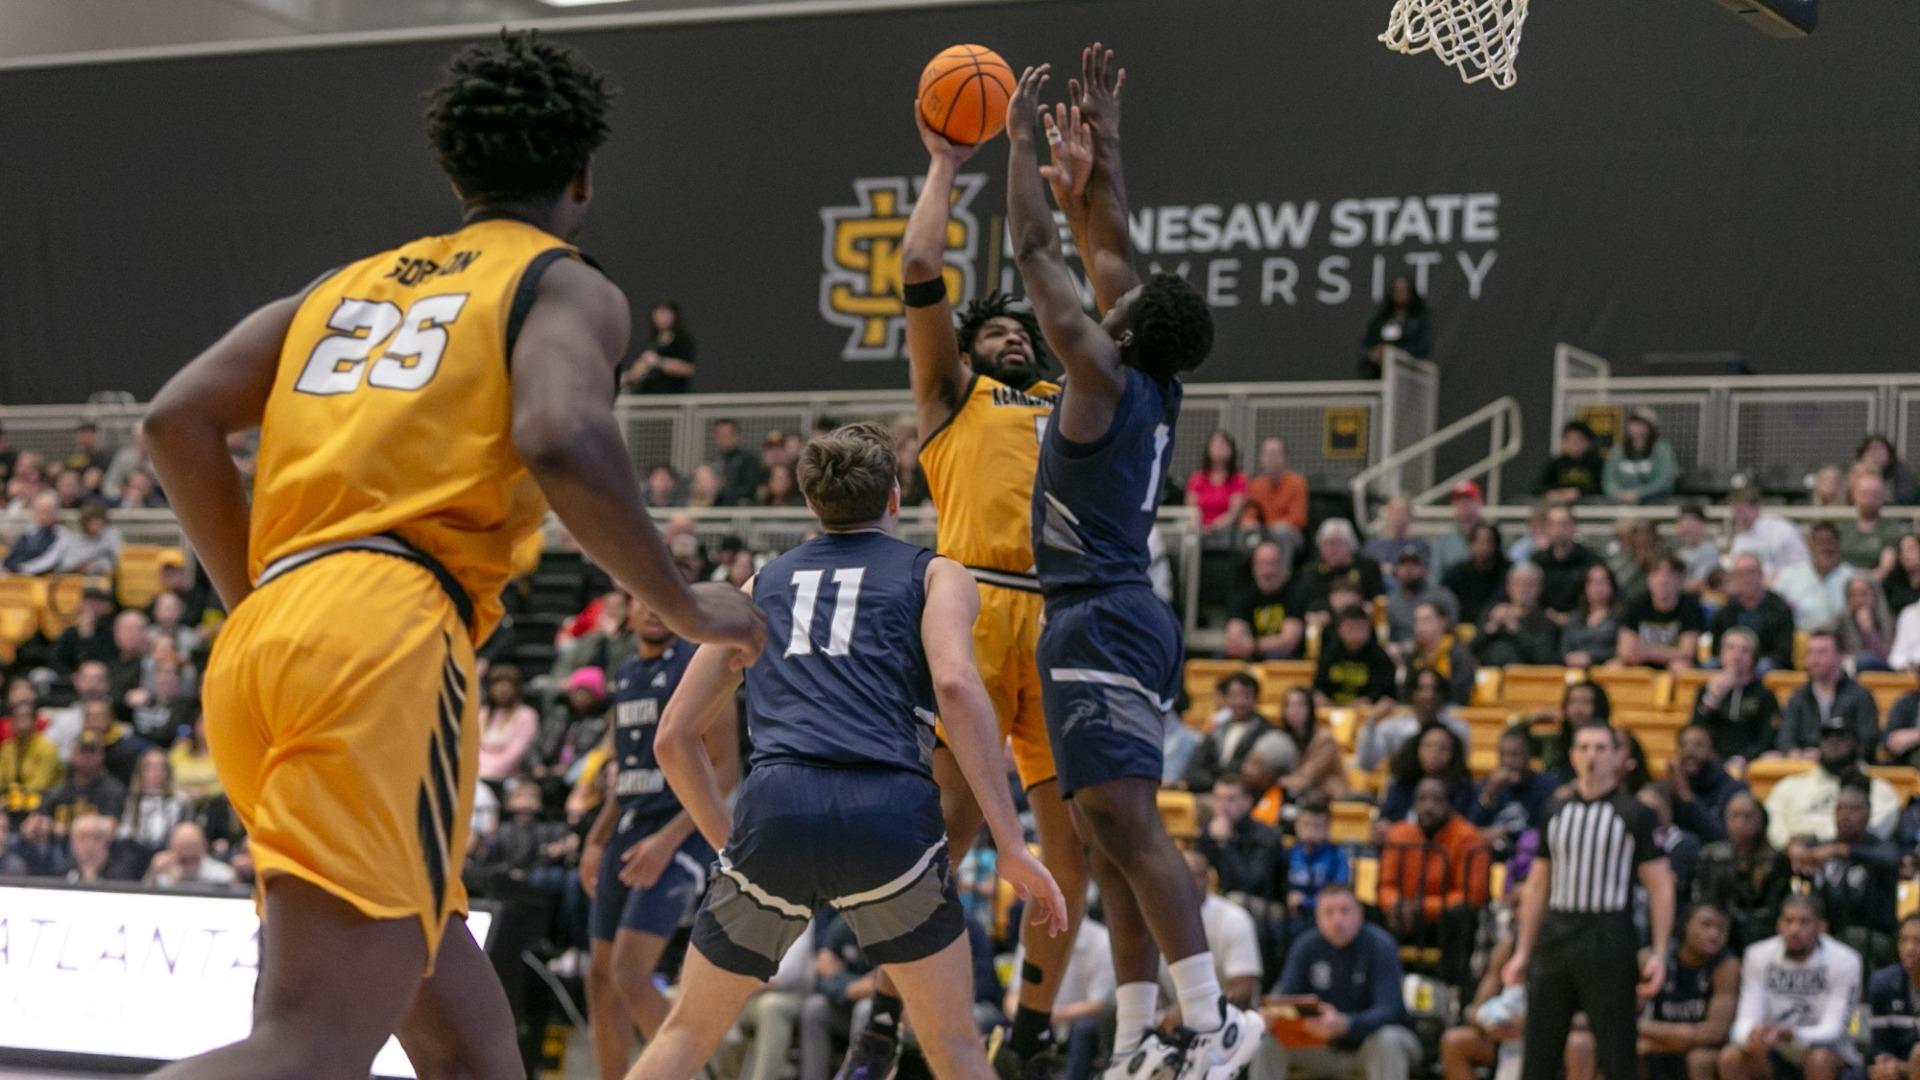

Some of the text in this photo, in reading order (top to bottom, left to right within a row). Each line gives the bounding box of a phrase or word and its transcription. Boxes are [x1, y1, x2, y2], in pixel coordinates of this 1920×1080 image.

[1330, 192, 1500, 248] STATE
[1001, 248, 1498, 311] ERSITY
[293, 292, 470, 395] 25
[1140, 422, 1170, 511] 1
[784, 567, 866, 659] 11
